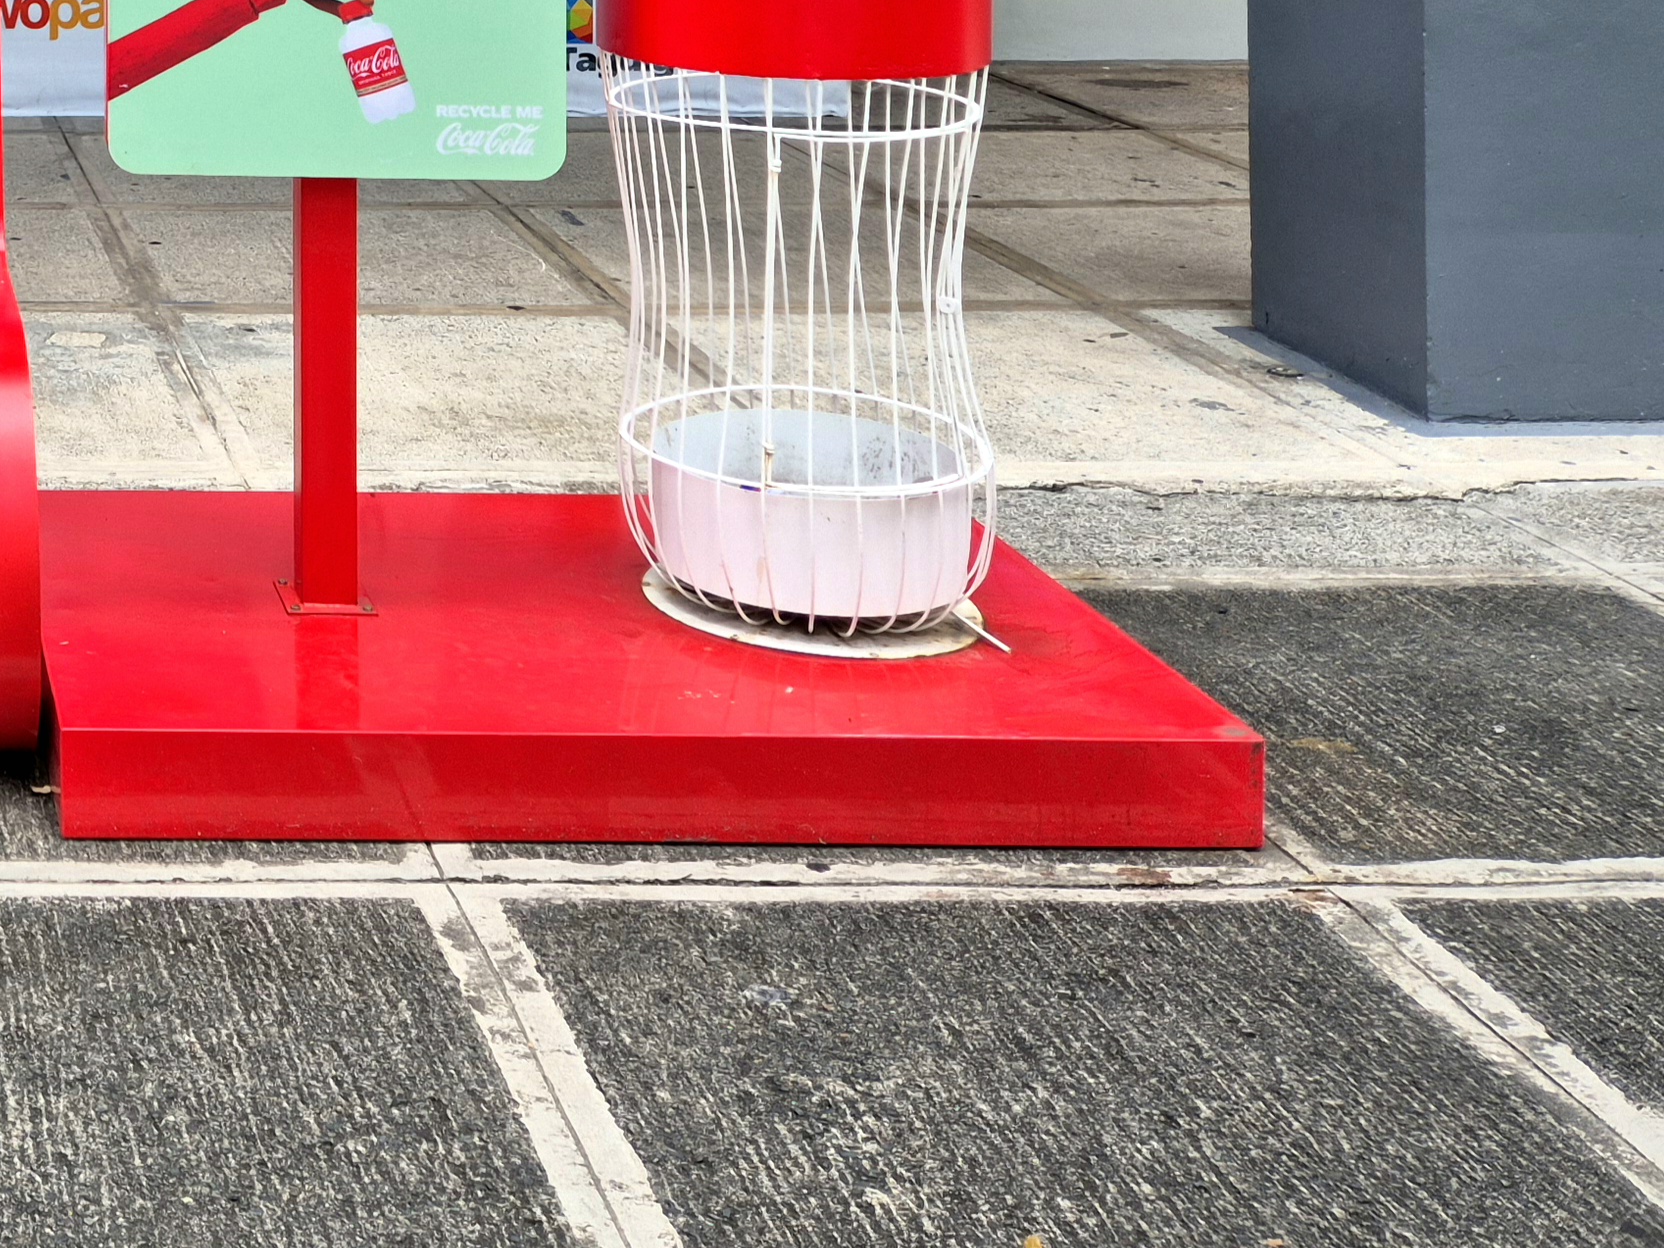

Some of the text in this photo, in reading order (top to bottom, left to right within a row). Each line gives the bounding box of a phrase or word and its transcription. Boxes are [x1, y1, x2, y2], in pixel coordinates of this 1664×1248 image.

[436, 105, 544, 119] RECYCLE ME
[437, 122, 540, 156] Coca-Cola
